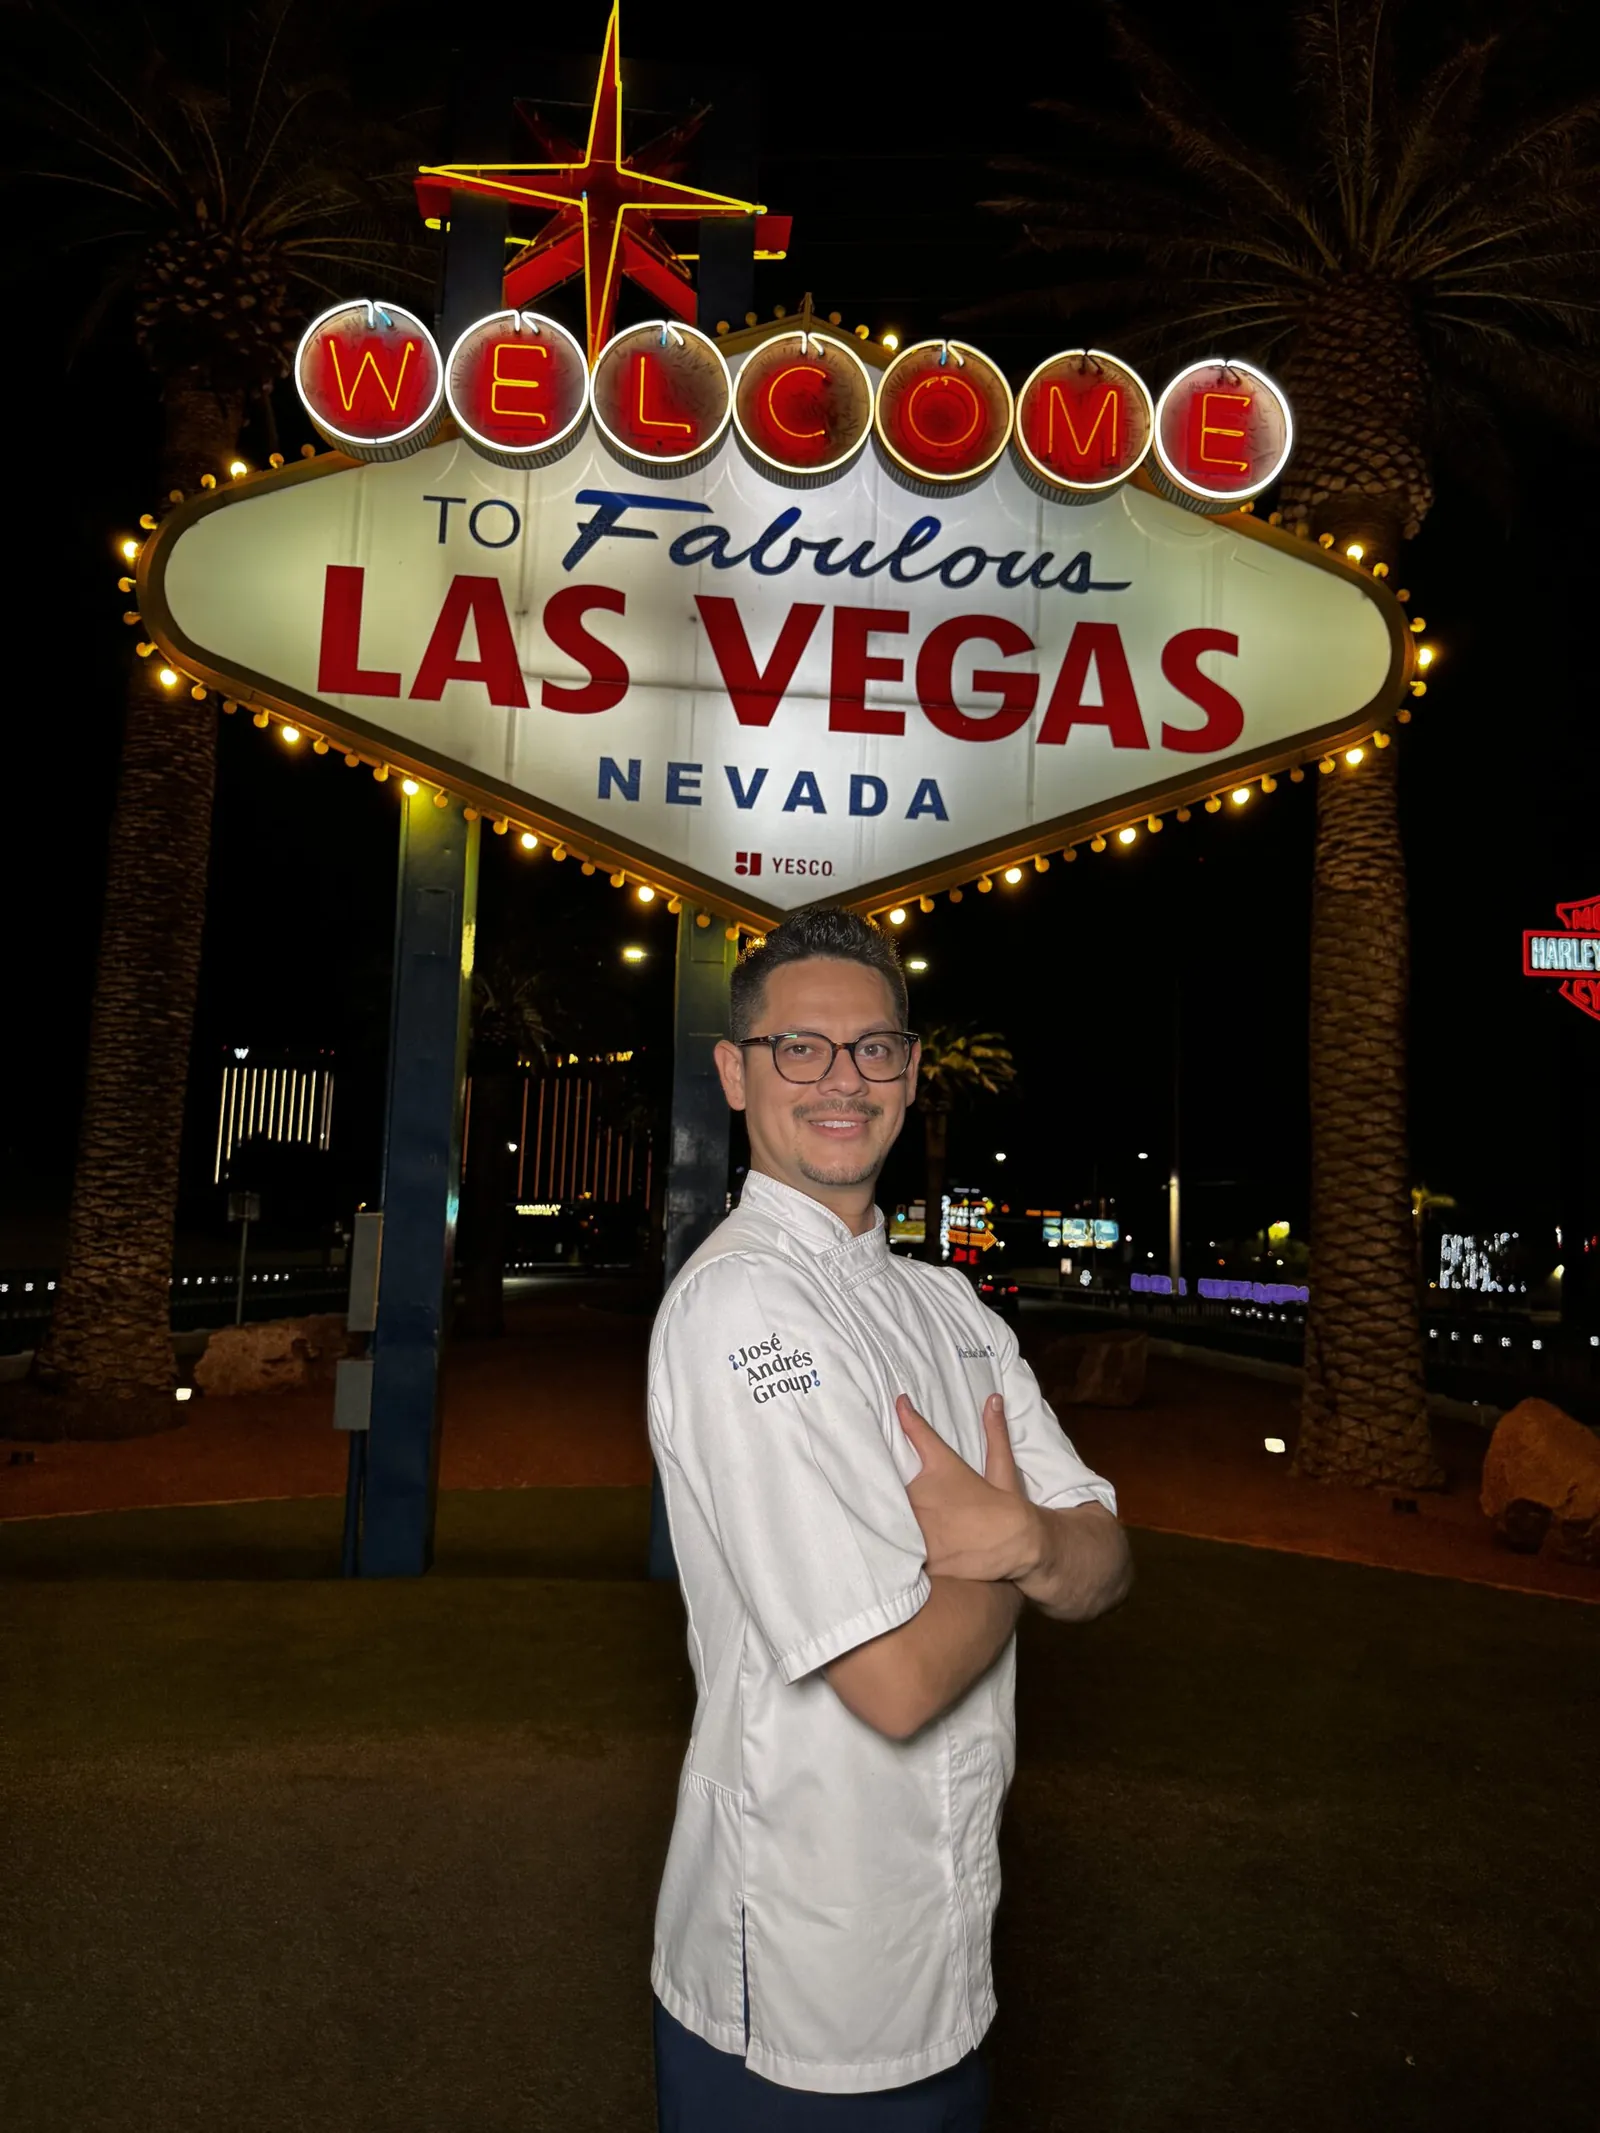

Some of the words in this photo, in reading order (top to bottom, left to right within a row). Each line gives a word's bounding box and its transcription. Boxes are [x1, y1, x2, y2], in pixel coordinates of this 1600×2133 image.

[321, 332, 1254, 476] WELCOME
[422, 494, 521, 550] TO
[561, 488, 1132, 592] Fabulous
[316, 564, 631, 716] LAS
[692, 594, 1246, 755] VEGAS
[597, 756, 950, 822] NEVADA
[771, 857, 834, 877] YESCO
[746, 1349, 813, 1387] Andrés
[753, 1369, 821, 1404] Group!
